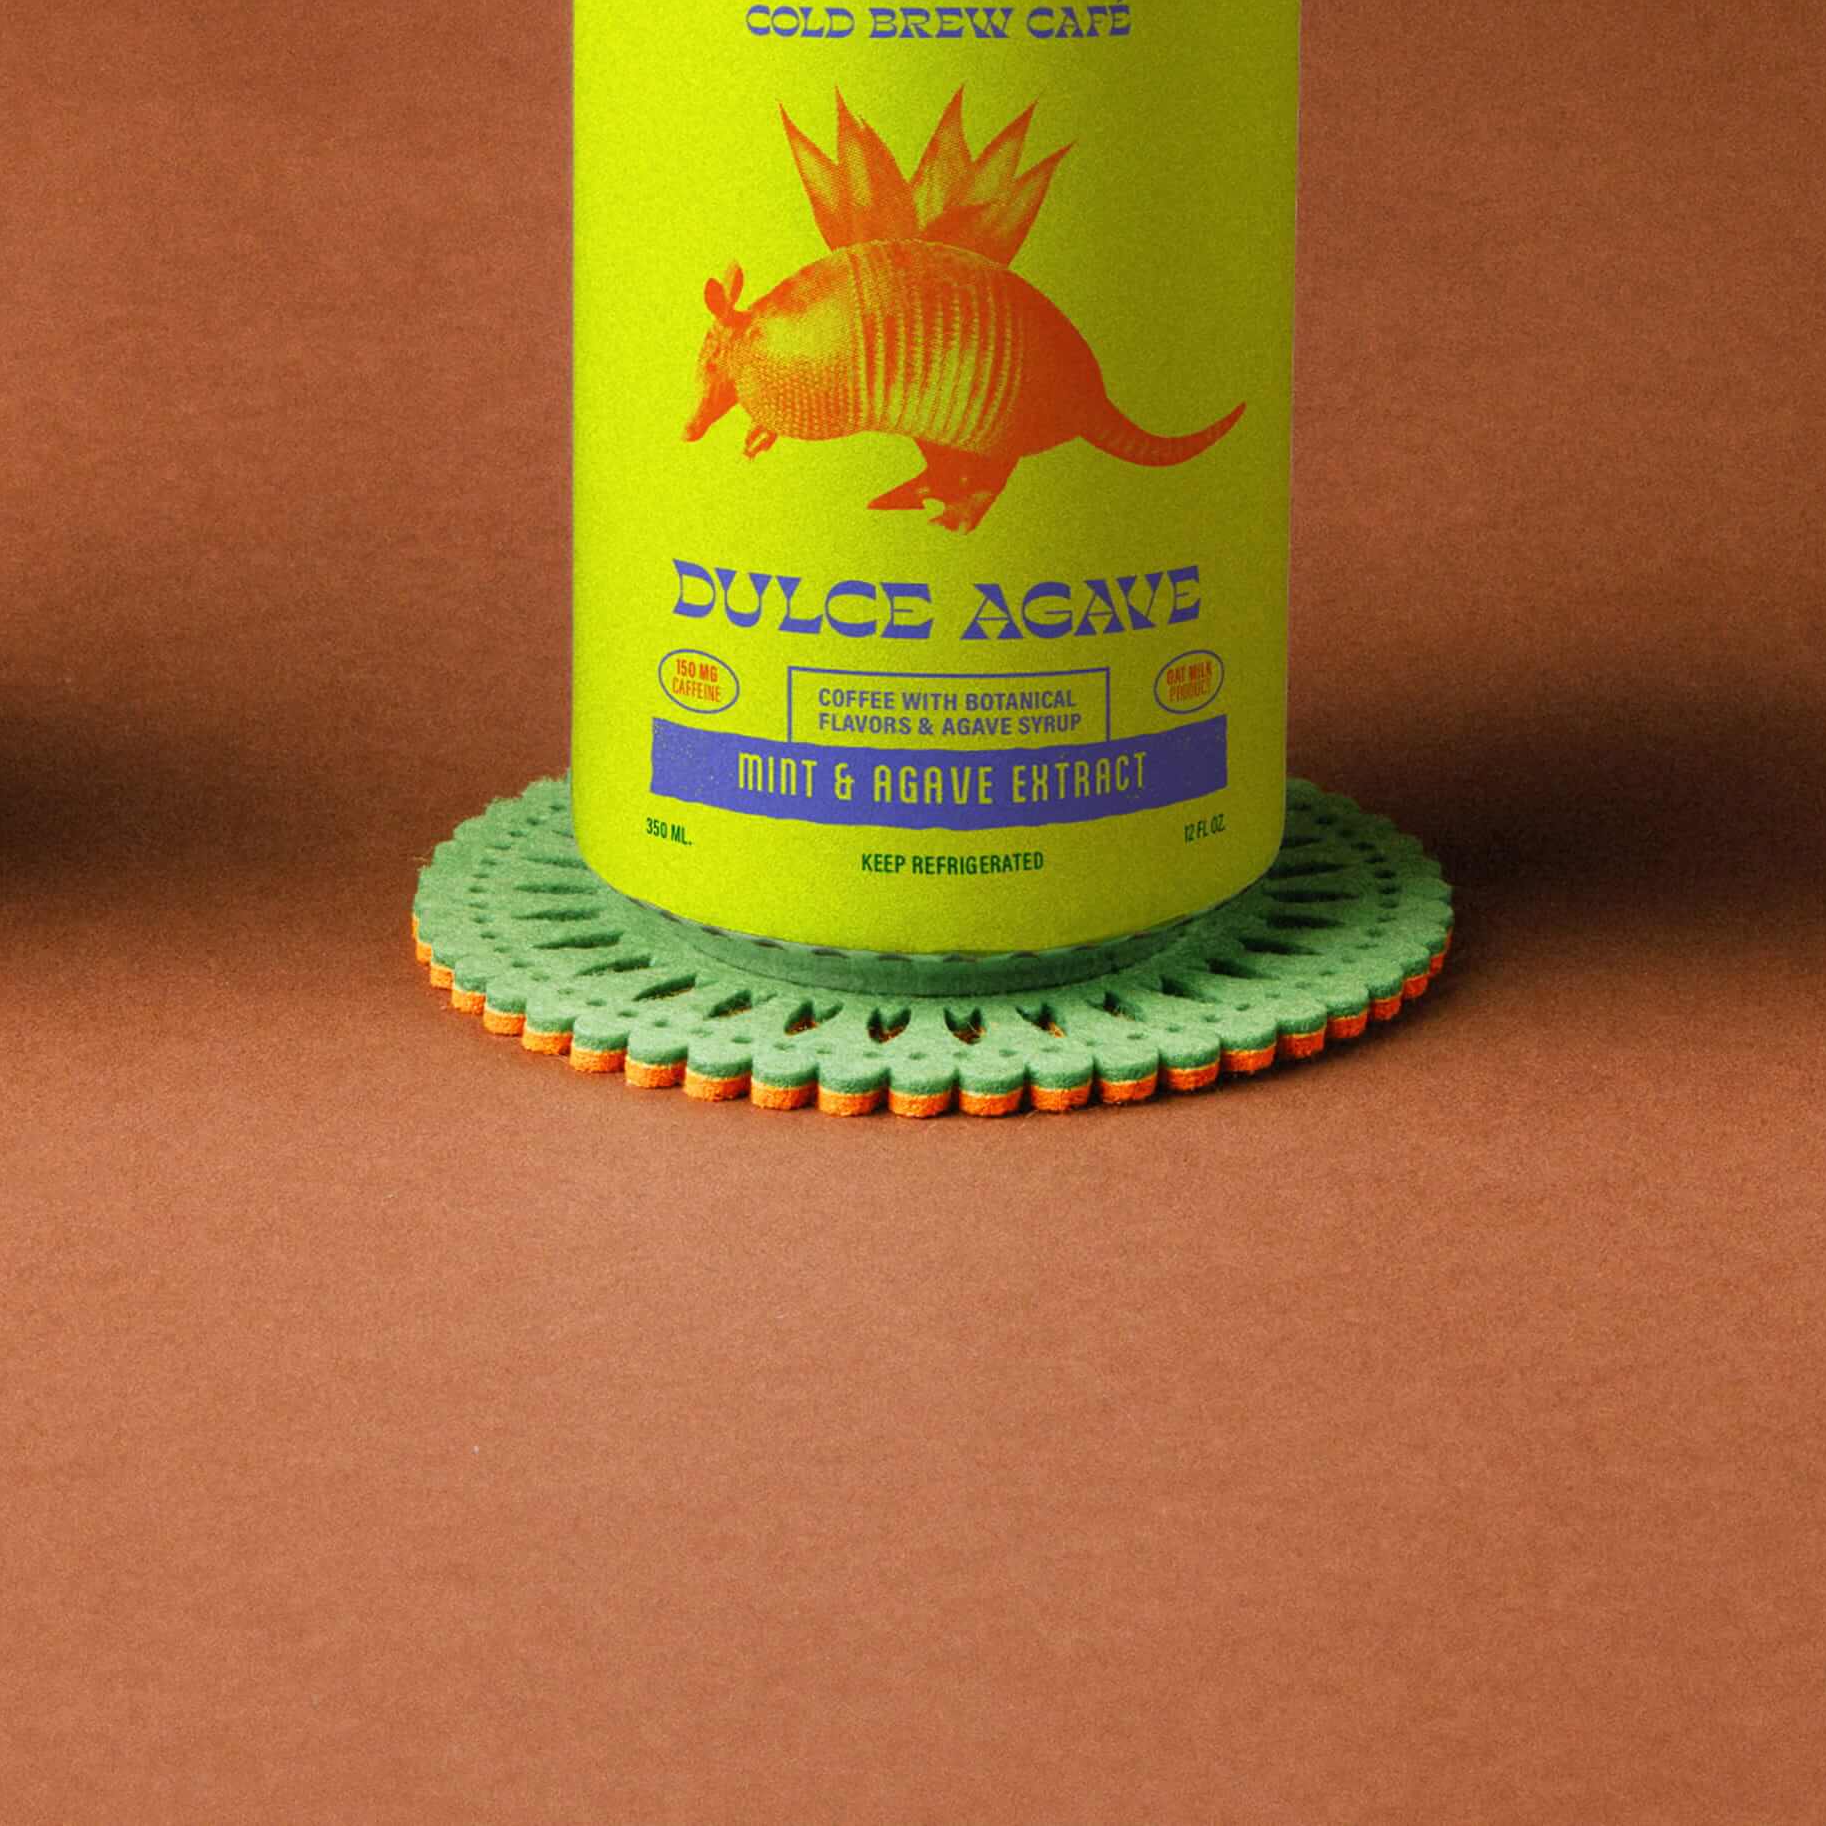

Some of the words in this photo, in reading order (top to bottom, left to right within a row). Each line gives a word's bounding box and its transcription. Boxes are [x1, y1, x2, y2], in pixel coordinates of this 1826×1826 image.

[745, 4, 855, 39] COLD
[868, 6, 1015, 40] BREW
[672, 558, 934, 639] DULCE
[960, 565, 1202, 639] AGAVE
[676, 658, 696, 678] 150
[699, 664, 719, 683] MG
[671, 676, 721, 703] CAFFEINE
[818, 687, 895, 710] COFFEE
[902, 691, 958, 712] WITH
[965, 689, 1077, 711] BOTANICAL
[818, 712, 912, 735] FLAVORS
[917, 716, 934, 736] &
[941, 716, 1013, 736] AGAVE
[1018, 713, 1082, 735] SYRUP
[738, 751, 818, 798] MINT
[834, 762, 854, 801] &
[873, 764, 993, 805] AGAVE
[1012, 751, 1148, 803] EXTRACT
[646, 816, 668, 839] 350
[670, 824, 693, 846] ML.
[1183, 824, 1195, 843] 12
[1197, 819, 1208, 838] FL
[861, 853, 906, 874] KEEP
[912, 851, 1044, 874] REFRIGERATED
